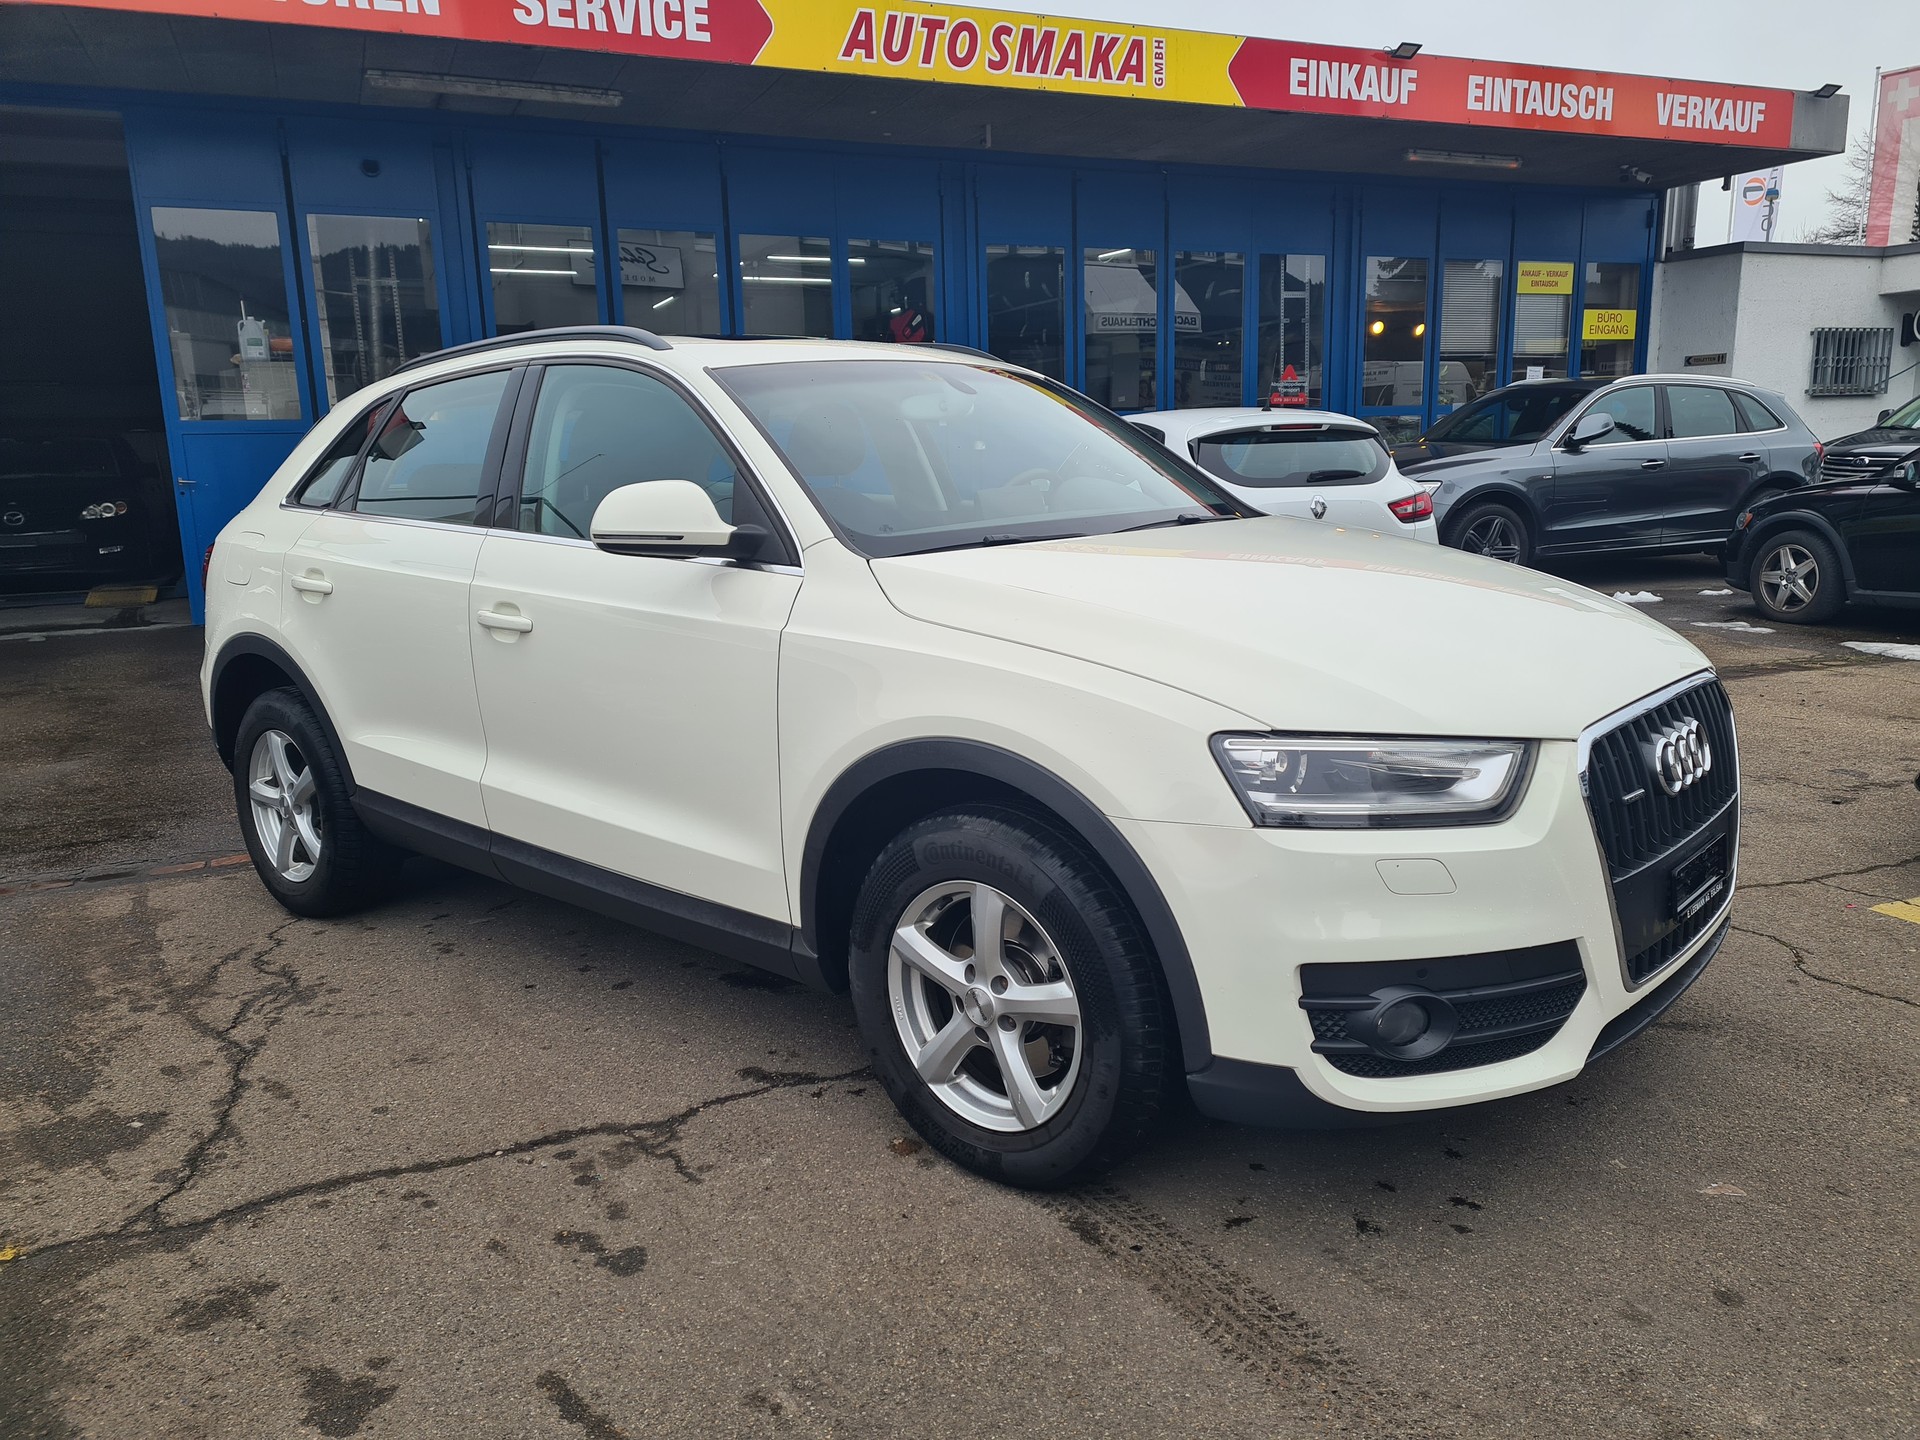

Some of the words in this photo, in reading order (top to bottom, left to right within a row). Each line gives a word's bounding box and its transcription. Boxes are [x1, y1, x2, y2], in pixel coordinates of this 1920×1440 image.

[513, 0, 711, 43] SERVICE
[839, 9, 980, 70] AUTO
[986, 24, 1146, 85] SMAKA
[1154, 39, 1164, 87] GMBH
[1290, 57, 1418, 105] EINKAUF
[1467, 75, 1613, 121] EINTAUSCH
[1656, 92, 1766, 134] VERKAUF
[1546, 270, 1569, 278] VERKAUF
[1589, 324, 1629, 335] EINGANG
[1597, 312, 1623, 323] BÜRO
